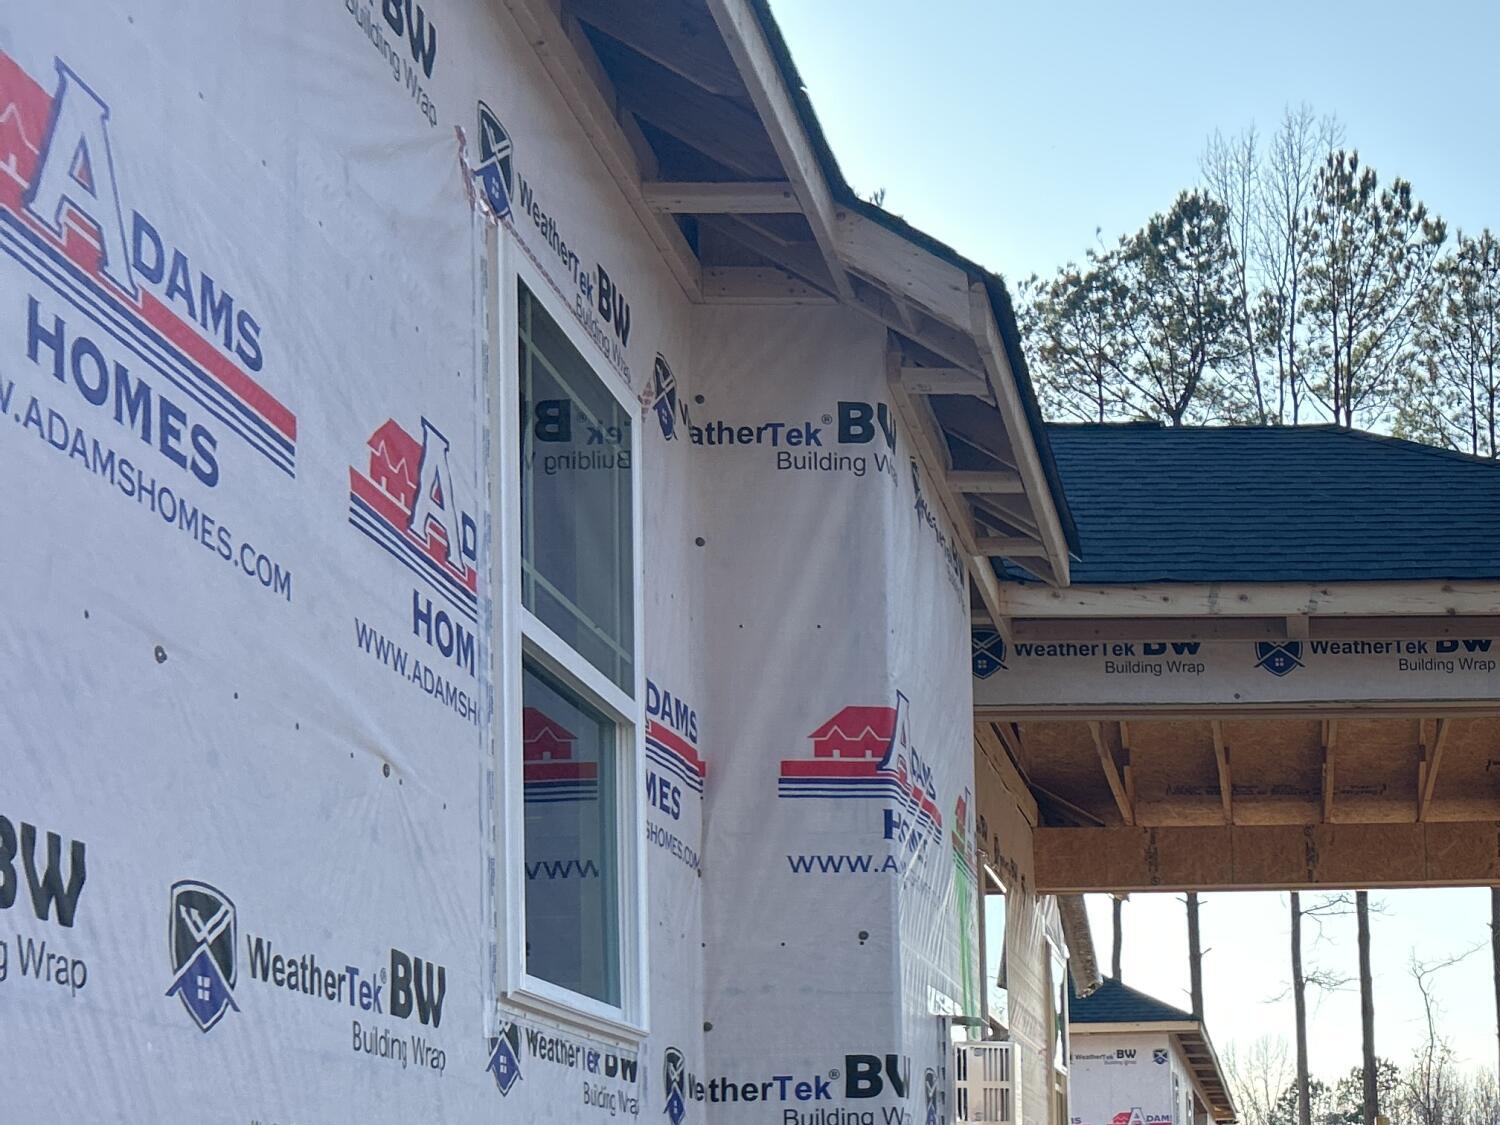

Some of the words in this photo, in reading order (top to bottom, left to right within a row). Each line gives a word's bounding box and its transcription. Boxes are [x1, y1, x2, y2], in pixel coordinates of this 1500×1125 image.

[403, 58, 437, 128] Wrap
[22, 56, 263, 372] ADAMS
[596, 262, 631, 347] BW
[27, 294, 219, 488] HOMES
[777, 452, 866, 477] Building
[355, 617, 481, 727] WWW.ADAMSH
[1105, 661, 1162, 676] Building
[1167, 660, 1205, 676] Wrap
[1399, 658, 1454, 674] Building
[1459, 657, 1496, 673] Wrap
[17, 934, 87, 998] Wrap
[390, 948, 445, 1029] BW
[353, 1020, 407, 1070] Building
[412, 1035, 446, 1077] Wrap
[1116, 1049, 1137, 1059] BW
[583, 1081, 616, 1117] Building
